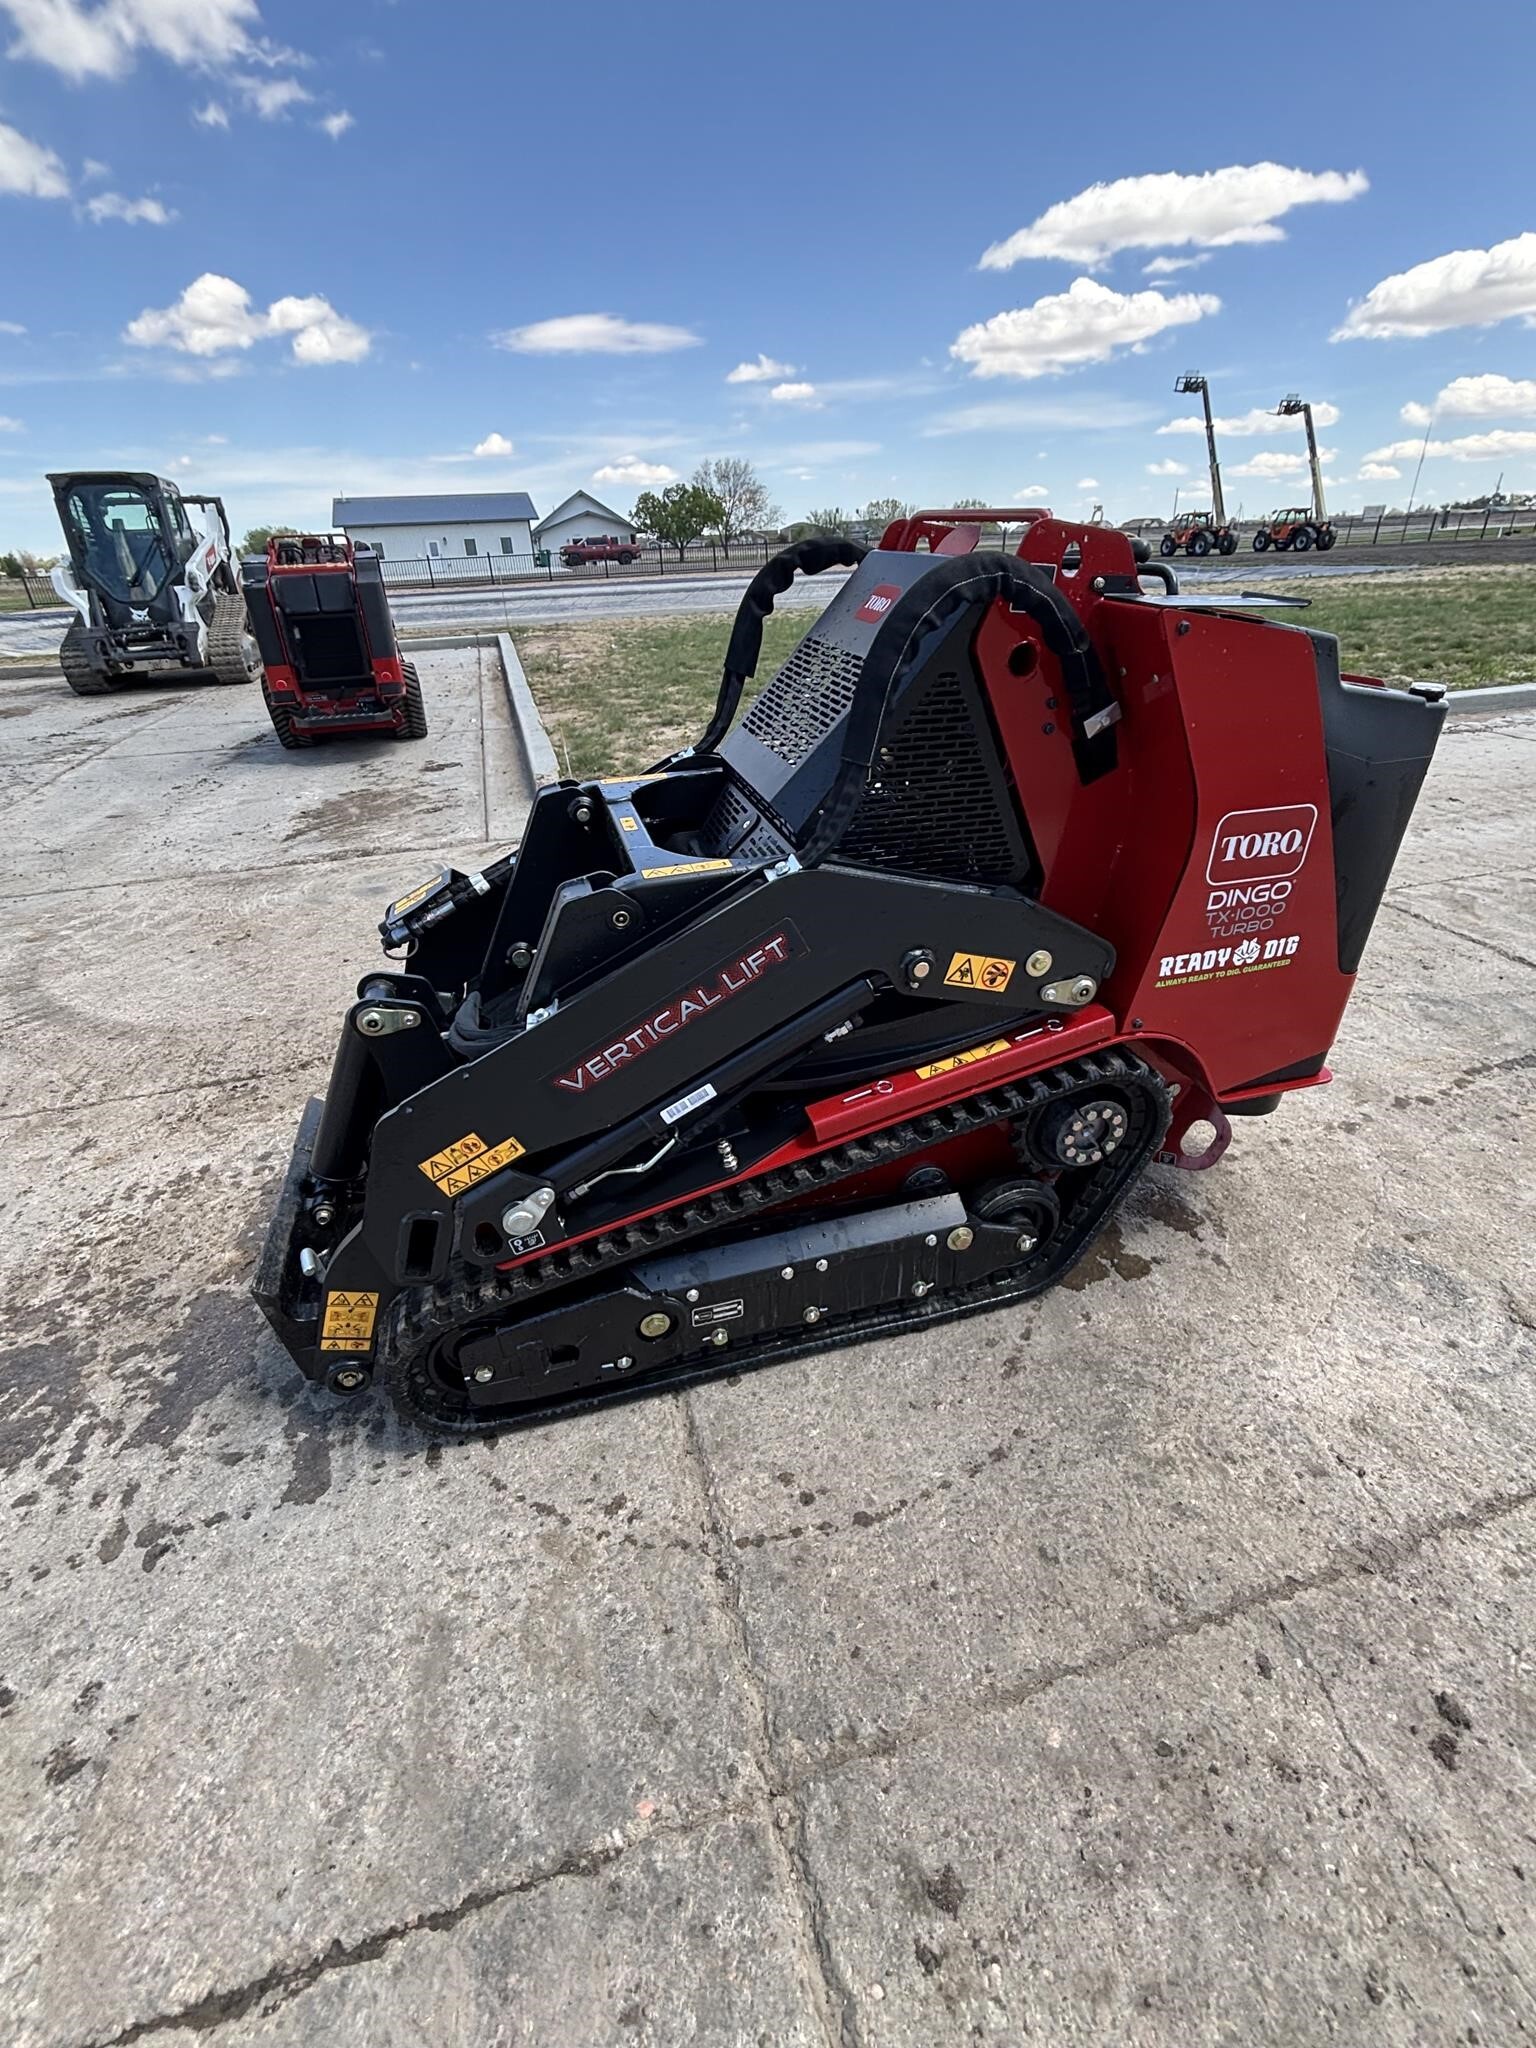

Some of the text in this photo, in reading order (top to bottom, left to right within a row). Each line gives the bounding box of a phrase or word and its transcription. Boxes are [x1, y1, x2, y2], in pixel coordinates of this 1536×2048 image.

[864, 594, 892, 612] TORO
[1221, 828, 1303, 862] TORO
[1206, 881, 1293, 911] DINGO
[1210, 918, 1274, 939] TURBO
[1158, 935, 1300, 977] READY DIG
[1154, 977, 1188, 988] ALWAYS
[1188, 972, 1215, 983] READY
[1215, 970, 1226, 978] TO
[1242, 958, 1291, 974] GUARANTEED
[558, 935, 786, 1091] VERTICAL LIFT
